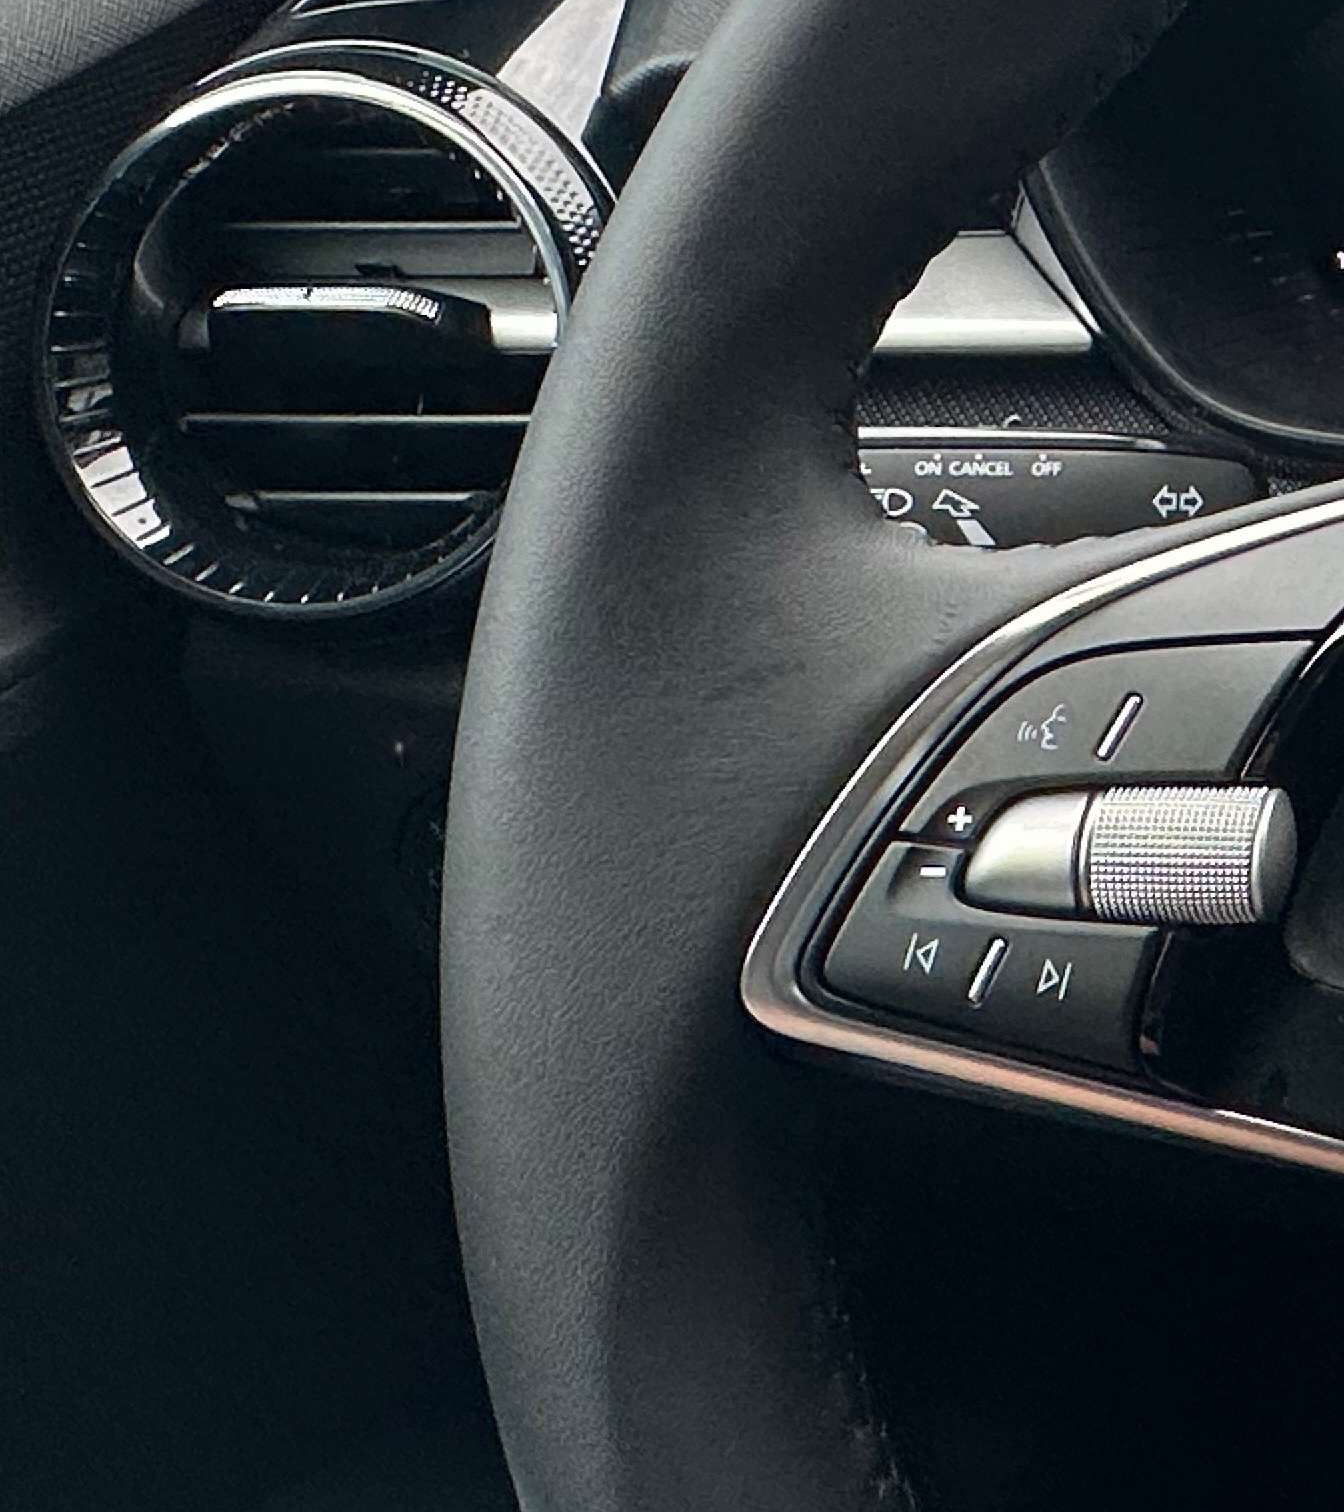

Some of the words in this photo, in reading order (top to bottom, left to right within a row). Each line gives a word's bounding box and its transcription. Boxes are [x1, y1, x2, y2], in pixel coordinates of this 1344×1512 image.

[914, 460, 943, 477] ON
[949, 460, 1015, 477] CANCEL
[1031, 460, 1064, 477] OFF
